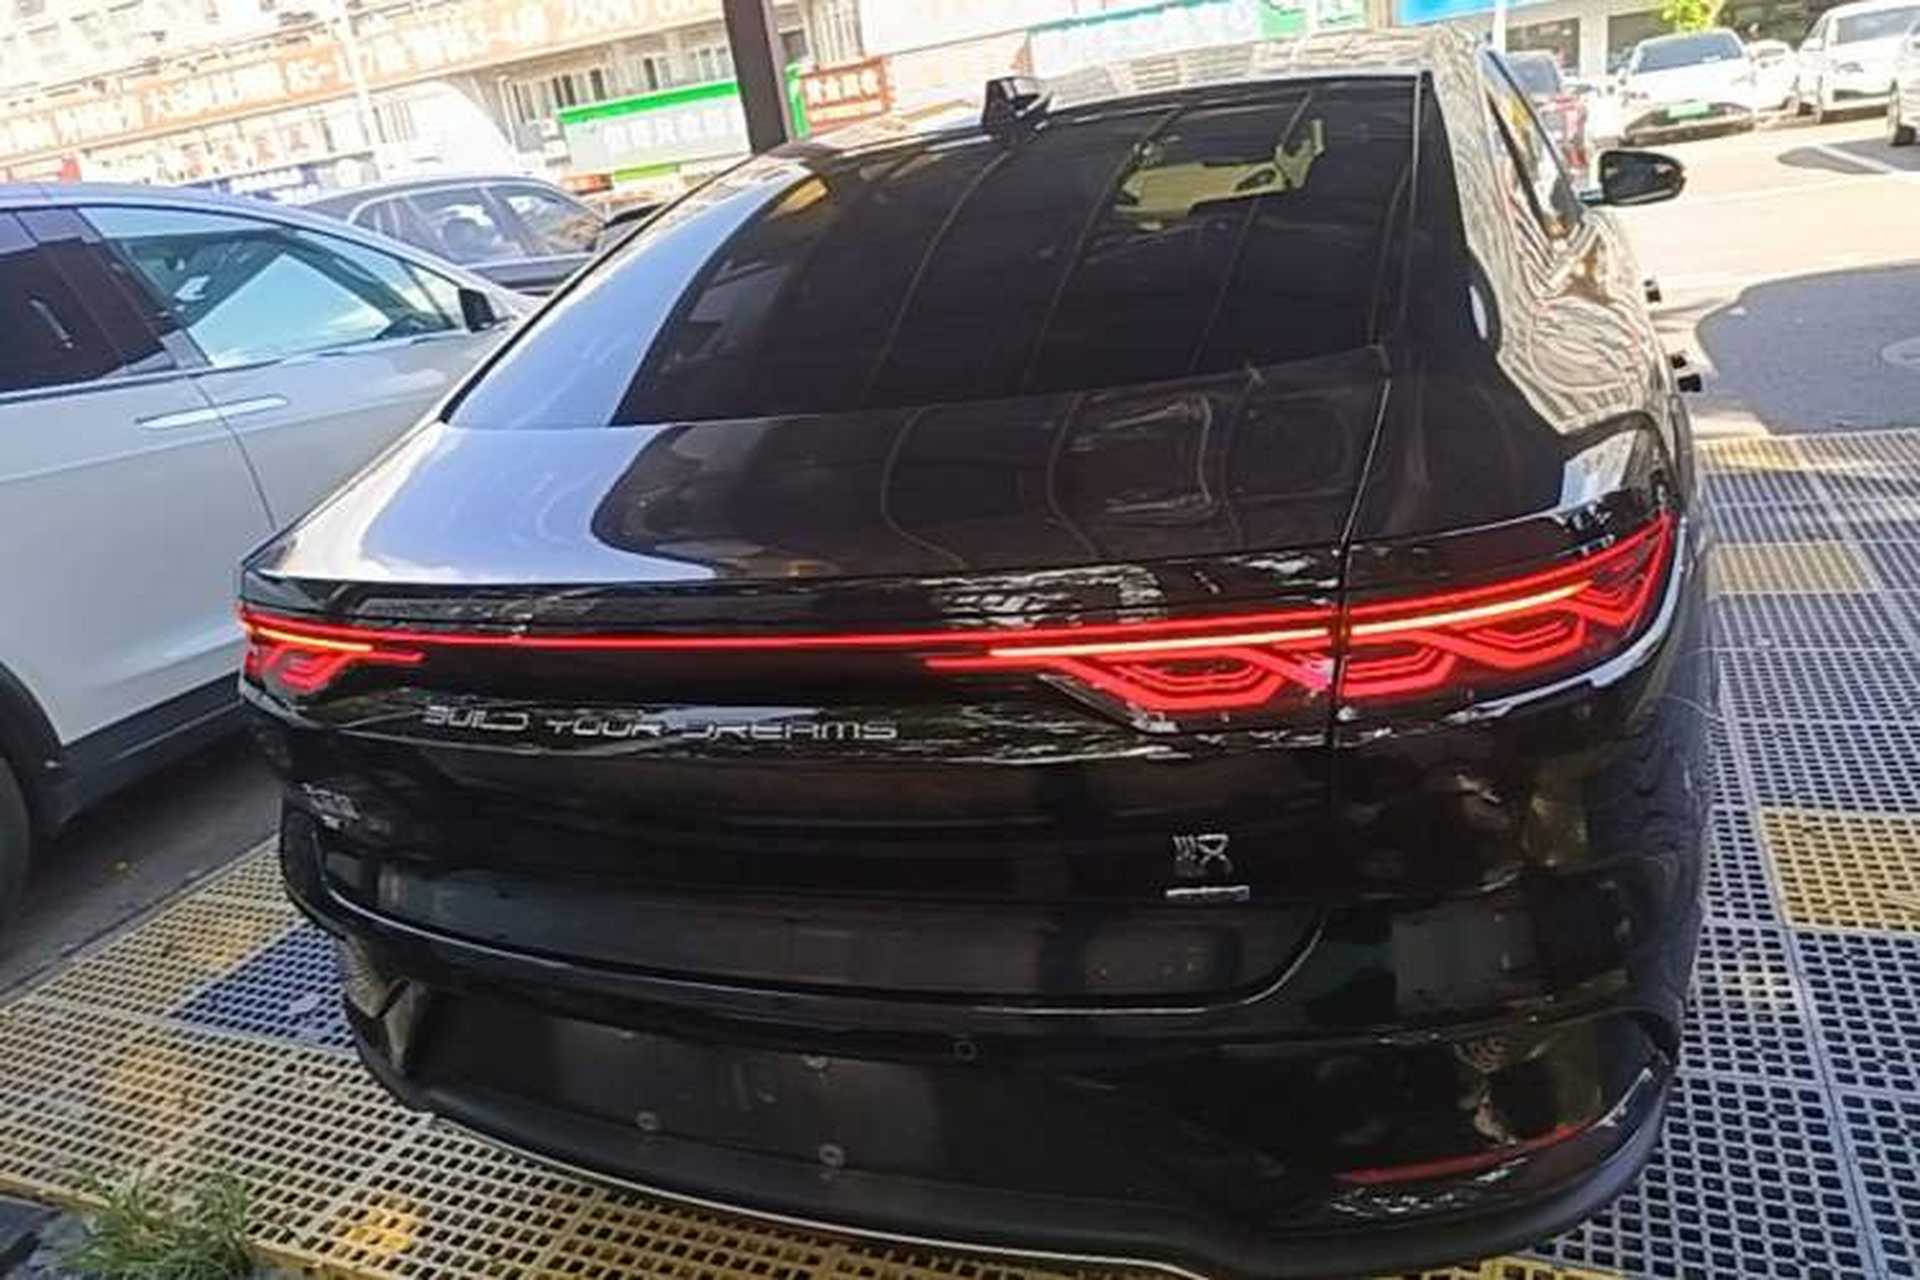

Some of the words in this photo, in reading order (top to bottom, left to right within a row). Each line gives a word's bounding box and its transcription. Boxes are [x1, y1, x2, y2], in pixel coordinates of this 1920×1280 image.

[422, 705, 529, 731] BUILD
[545, 713, 661, 737] YOUR
[681, 719, 898, 741] DREAMS
